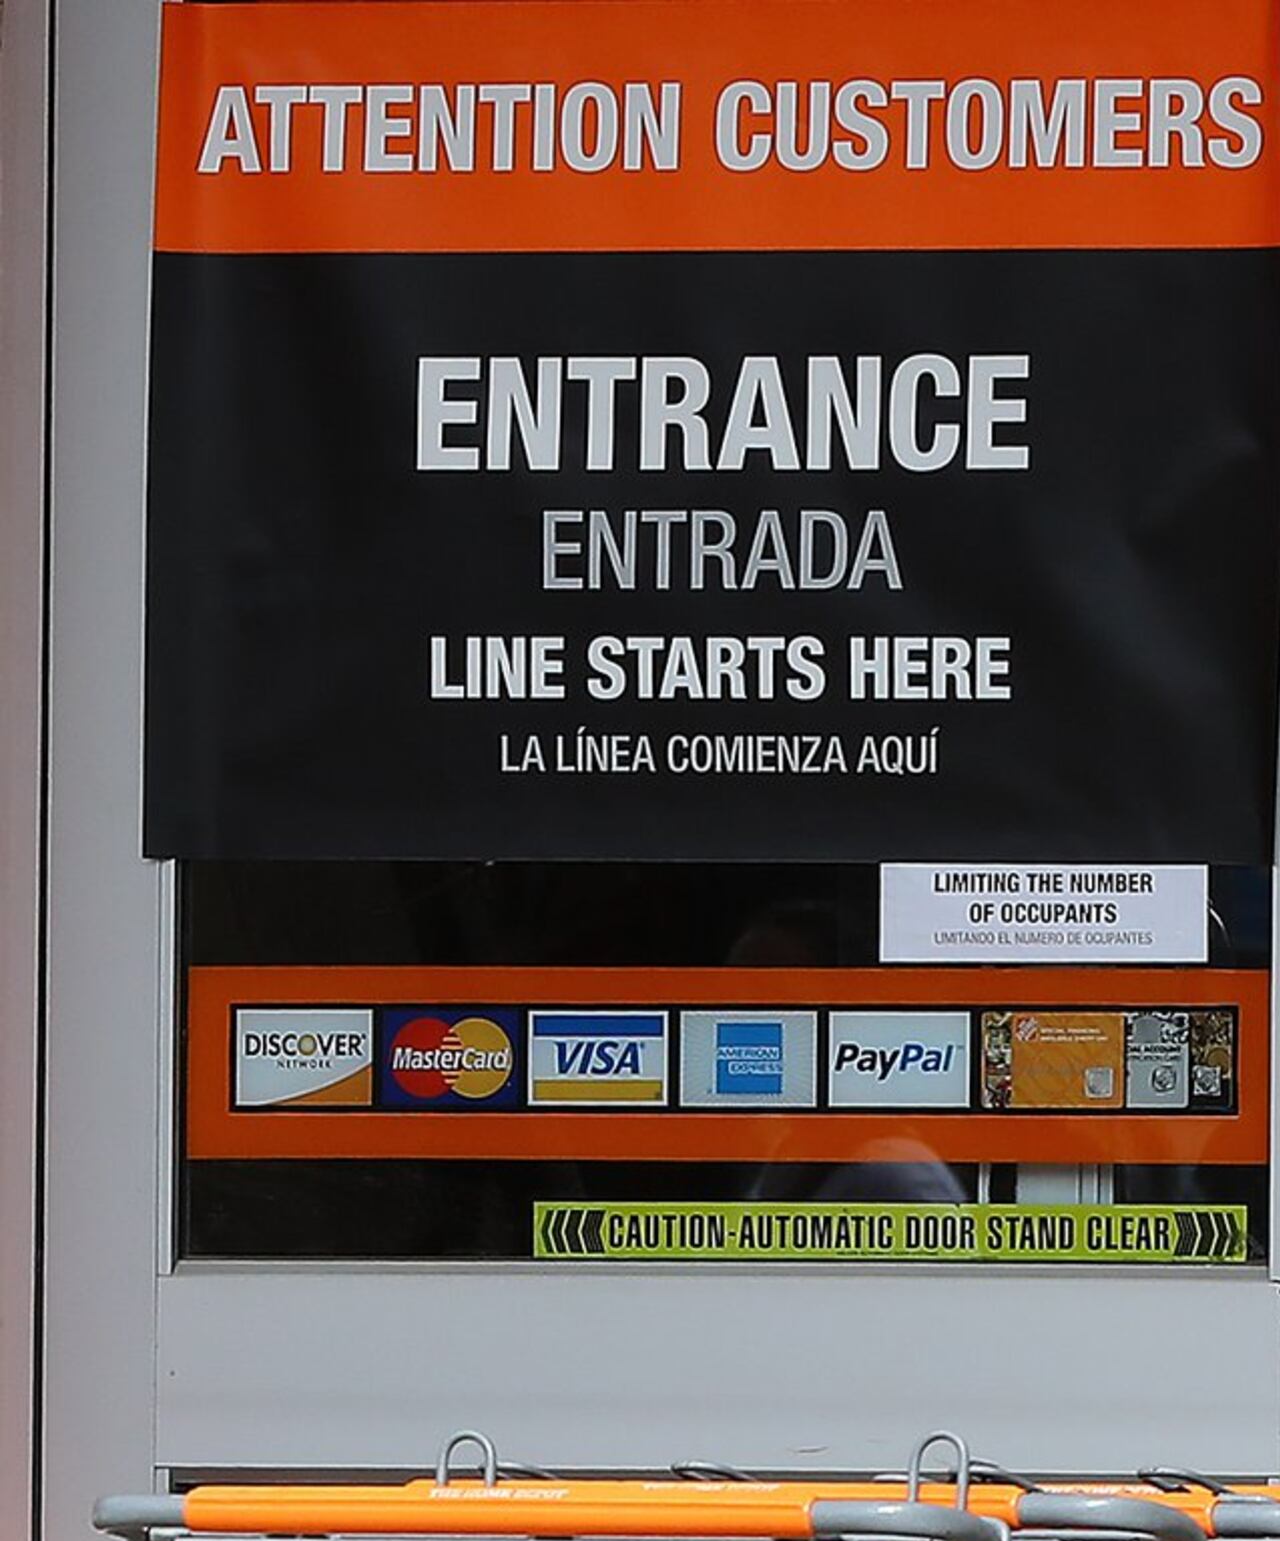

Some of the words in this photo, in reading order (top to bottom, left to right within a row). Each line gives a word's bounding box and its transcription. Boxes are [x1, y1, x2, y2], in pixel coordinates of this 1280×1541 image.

[198, 83, 681, 174] ATTENTION
[714, 77, 1264, 170] CUSTOMERS
[415, 353, 1031, 472] ENTRANCE
[541, 509, 903, 591] ENTRADA
[429, 637, 565, 701] LINE
[586, 636, 826, 701] STARTS
[849, 637, 1012, 701] HERE
[500, 734, 545, 773] LA
[553, 724, 656, 773] LÍNEA
[666, 734, 848, 774] COMIENZA
[857, 726, 939, 778] AQUÍ
[934, 872, 1019, 894] LIMITING
[1027, 872, 1064, 894] THE
[1069, 872, 1154, 894] NUMBER
[969, 902, 995, 924] OF
[1002, 902, 1118, 924] OCCUPANTS
[244, 1032, 363, 1057] DISCOVER
[392, 1046, 509, 1072] MasterCard
[554, 1040, 641, 1076] VISA
[717, 1047, 779, 1060] AMERICAN
[834, 1043, 954, 1082] PayPal
[276, 1059, 332, 1069] NETWORK
[729, 1061, 783, 1074] EXPRESS
[608, 1214, 893, 1251] CAUTION-AUTOMATIC
[906, 1214, 976, 1252] DOOR
[987, 1215, 1075, 1252] STAND
[1087, 1215, 1170, 1252] CLEAR
